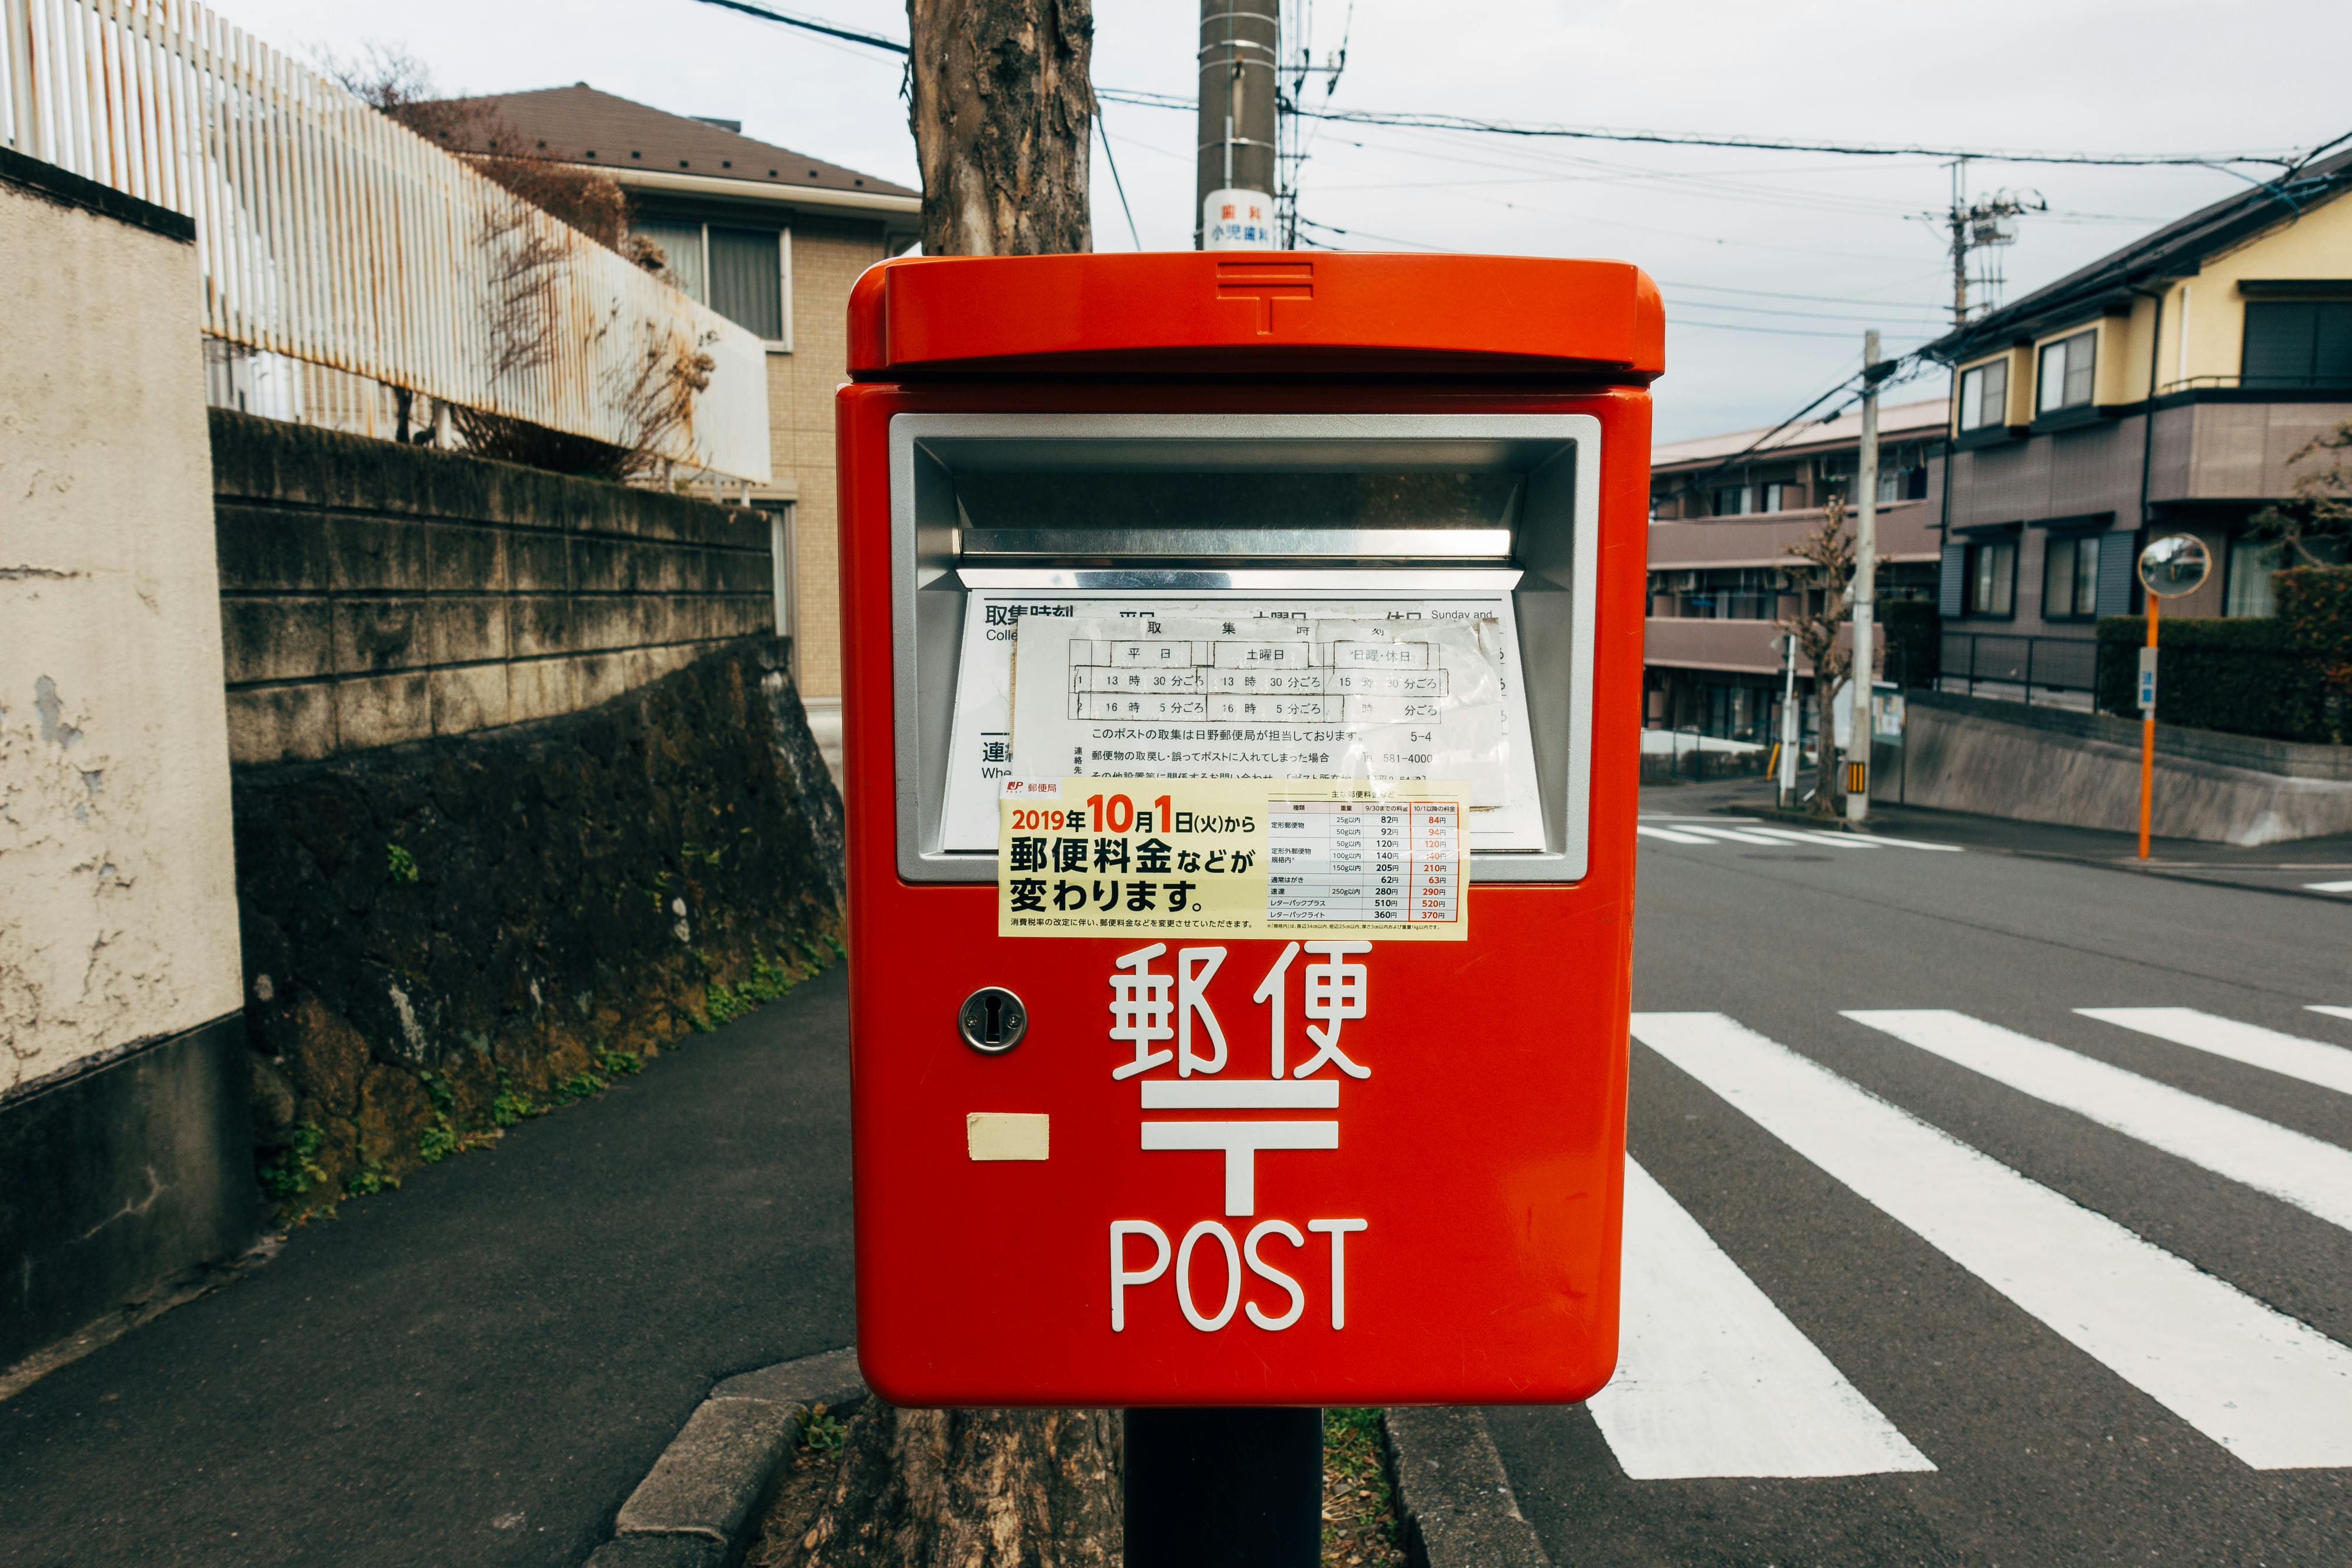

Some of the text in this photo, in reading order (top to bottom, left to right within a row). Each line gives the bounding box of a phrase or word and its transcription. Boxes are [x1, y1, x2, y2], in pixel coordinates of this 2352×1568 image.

[1474, 610, 1492, 618] and
[1247, 649, 1284, 660] 土曜日
[1107, 675, 1204, 686] 13 時 30 分ごろ
[1223, 676, 1320, 687] 13 時 30 分ごろ
[1340, 678, 1350, 686] 15
[1387, 679, 1398, 687] 30
[1404, 678, 1437, 689] 分ごろ
[1106, 702, 1203, 713] 16 時 5 分ごろ
[1245, 703, 1256, 714] 時
[1277, 705, 1282, 713] 5
[1288, 703, 1320, 714] 分ごろ
[1404, 705, 1437, 716] 分ごろ
[1411, 732, 1432, 742] 5-4
[1074, 746, 1083, 774] 連絡先
[1383, 754, 1433, 763] 581-4000
[1027, 783, 1057, 793] 郵便局
[1010, 836, 1256, 873] 郵便料金などが
[1010, 878, 1202, 913] 変わります。
[1109, 941, 1373, 1080] 郵便
[1110, 1219, 1368, 1332] POST
